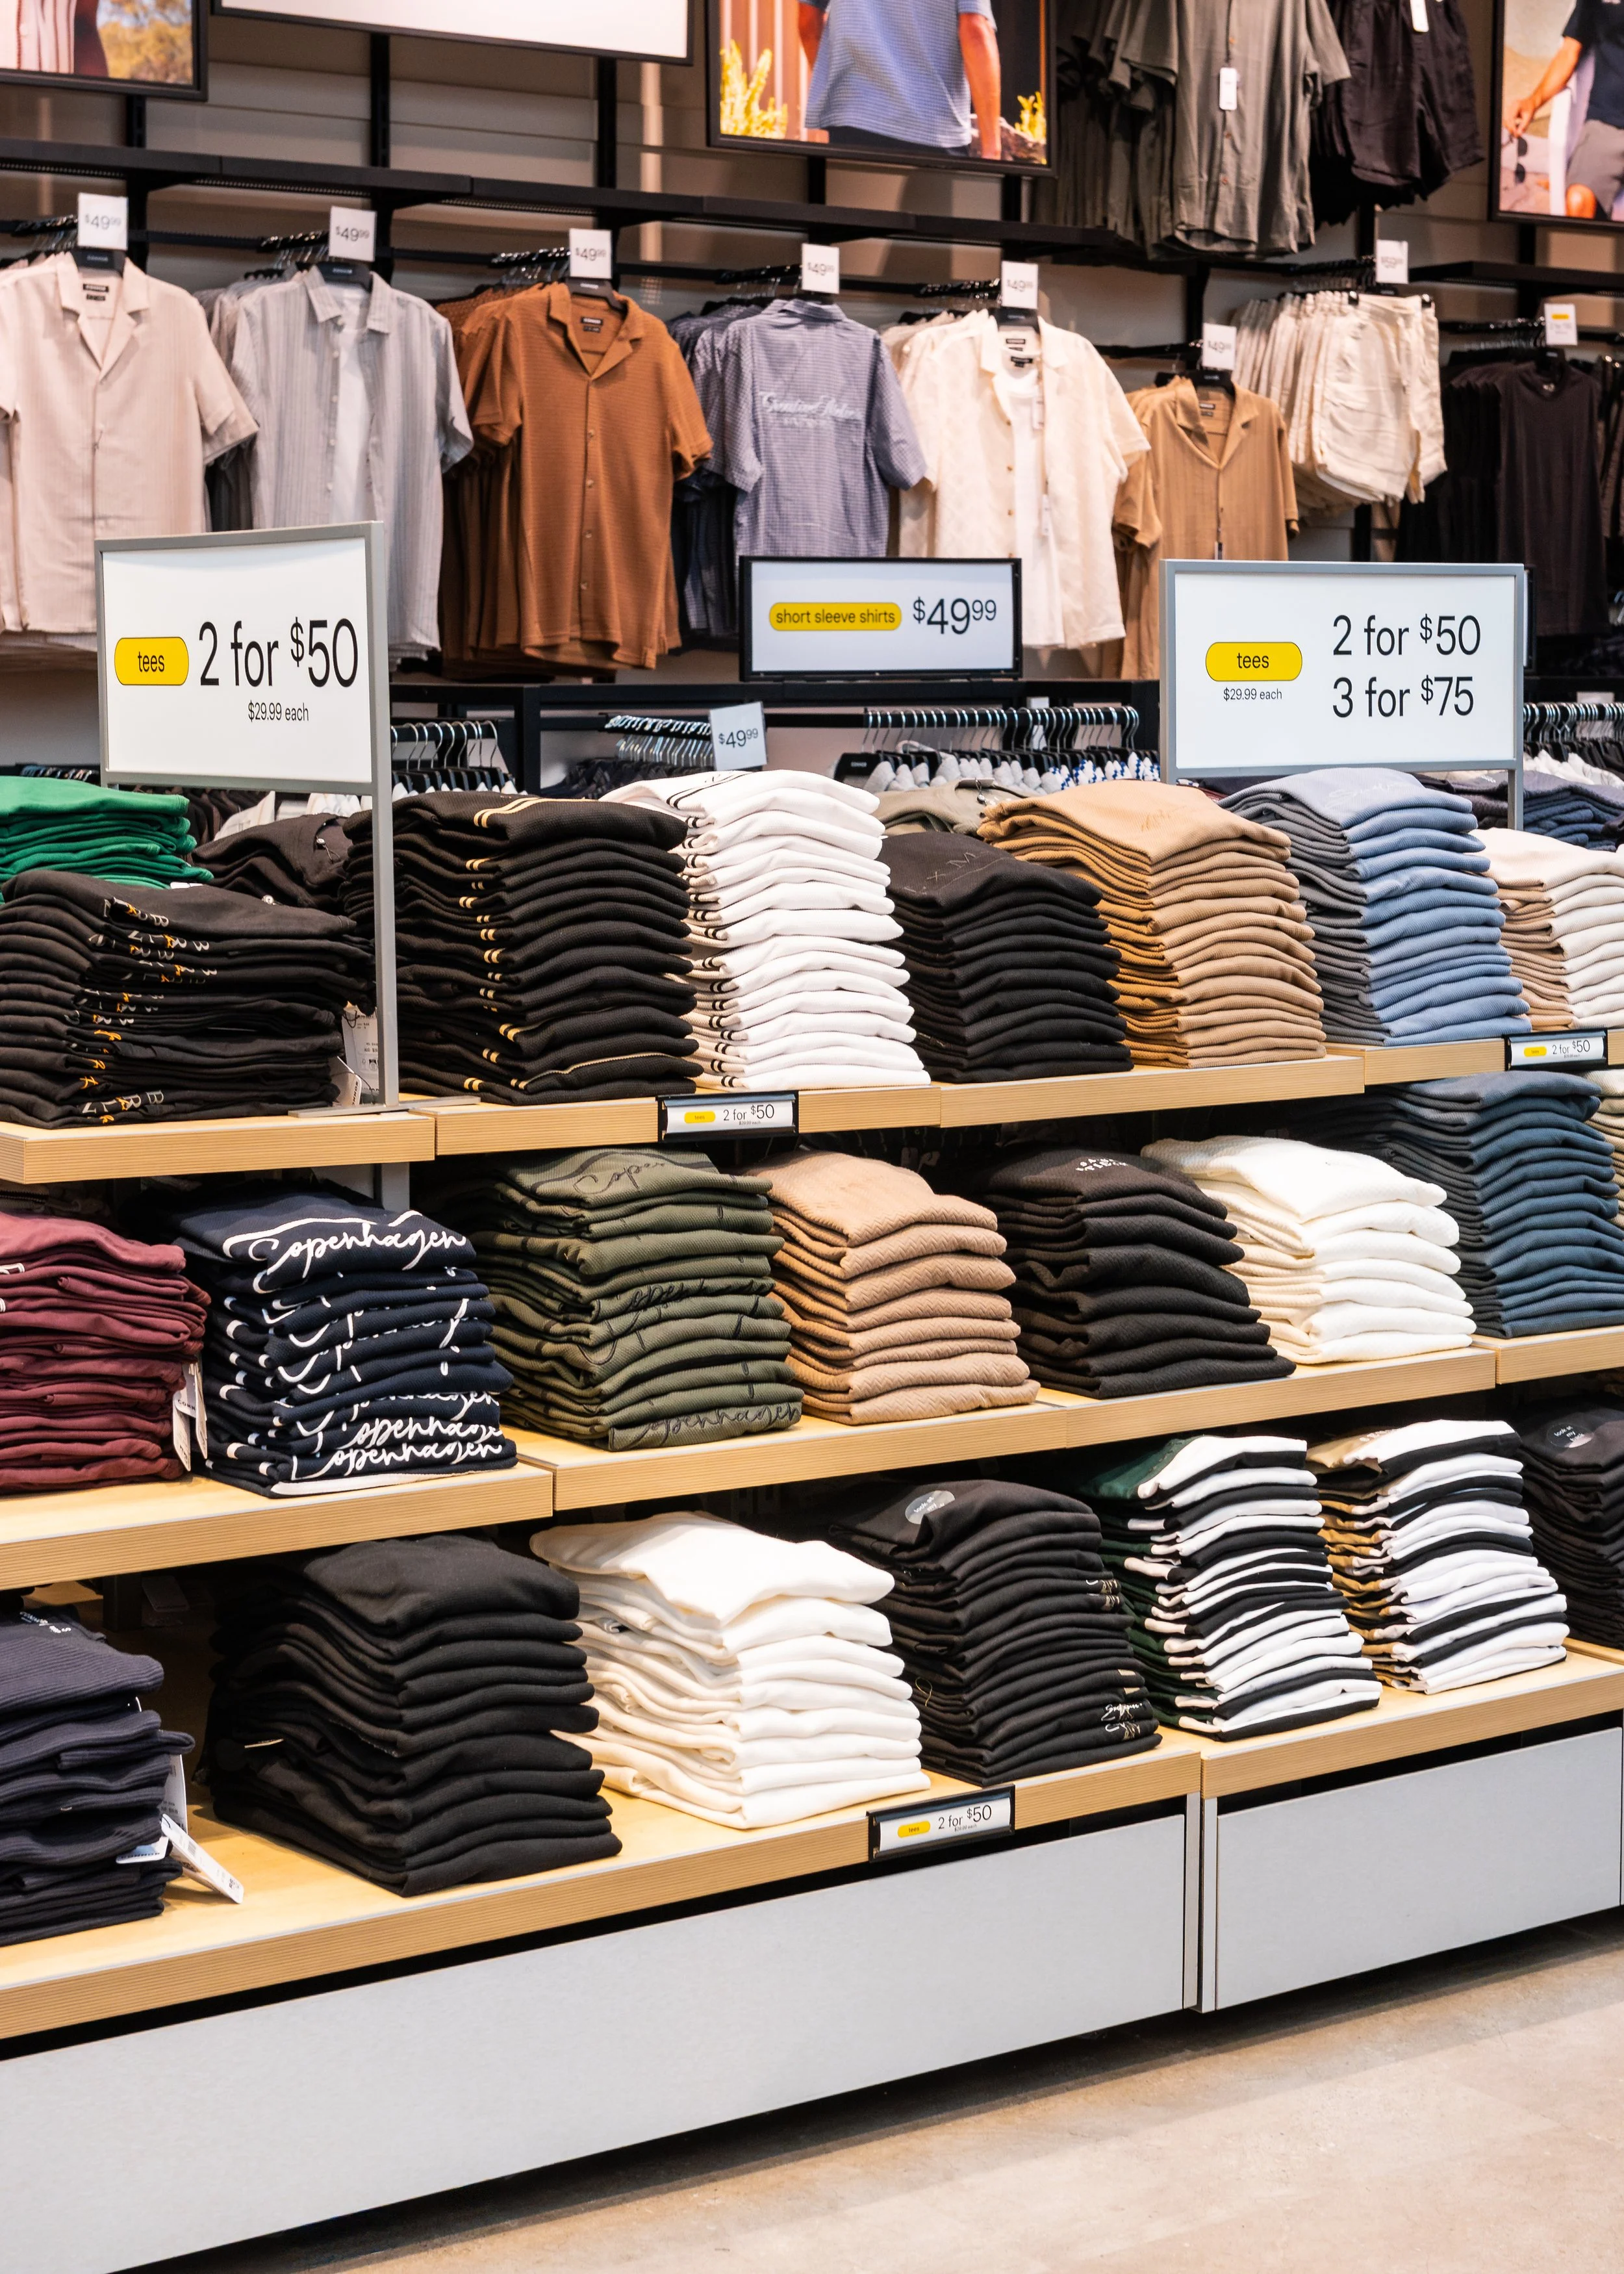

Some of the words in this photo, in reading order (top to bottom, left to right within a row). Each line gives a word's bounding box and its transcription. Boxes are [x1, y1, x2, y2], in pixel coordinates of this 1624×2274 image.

[776, 608, 811, 624] short
[815, 608, 856, 624] sleeve
[859, 608, 896, 624] shirts
[1332, 614, 1352, 656] 2
[1364, 614, 1410, 656] for
[1419, 613, 1481, 656] $50
[137, 651, 166, 673] tees
[198, 620, 220, 687] 2
[230, 620, 279, 687] for
[290, 616, 359, 688] $50
[1236, 652, 1270, 669] tees
[1223, 687, 1258, 702] $29.99
[1259, 687, 1282, 701] each
[1332, 676, 1354, 719] 3
[1365, 676, 1411, 717] for
[1420, 674, 1475, 717] $75
[247, 700, 283, 722] $29.99
[284, 702, 309, 722] each
[1552, 1044, 1557, 1054] 2
[1559, 1044, 1570, 1054] for
[1571, 1039, 1590, 1053] $50
[723, 1108, 730, 1121] 2
[733, 1108, 747, 1121] for
[750, 1104, 774, 1119] $50
[937, 1816, 945, 1830] 2
[948, 1815, 963, 1828] for
[967, 1804, 993, 1823] $50
